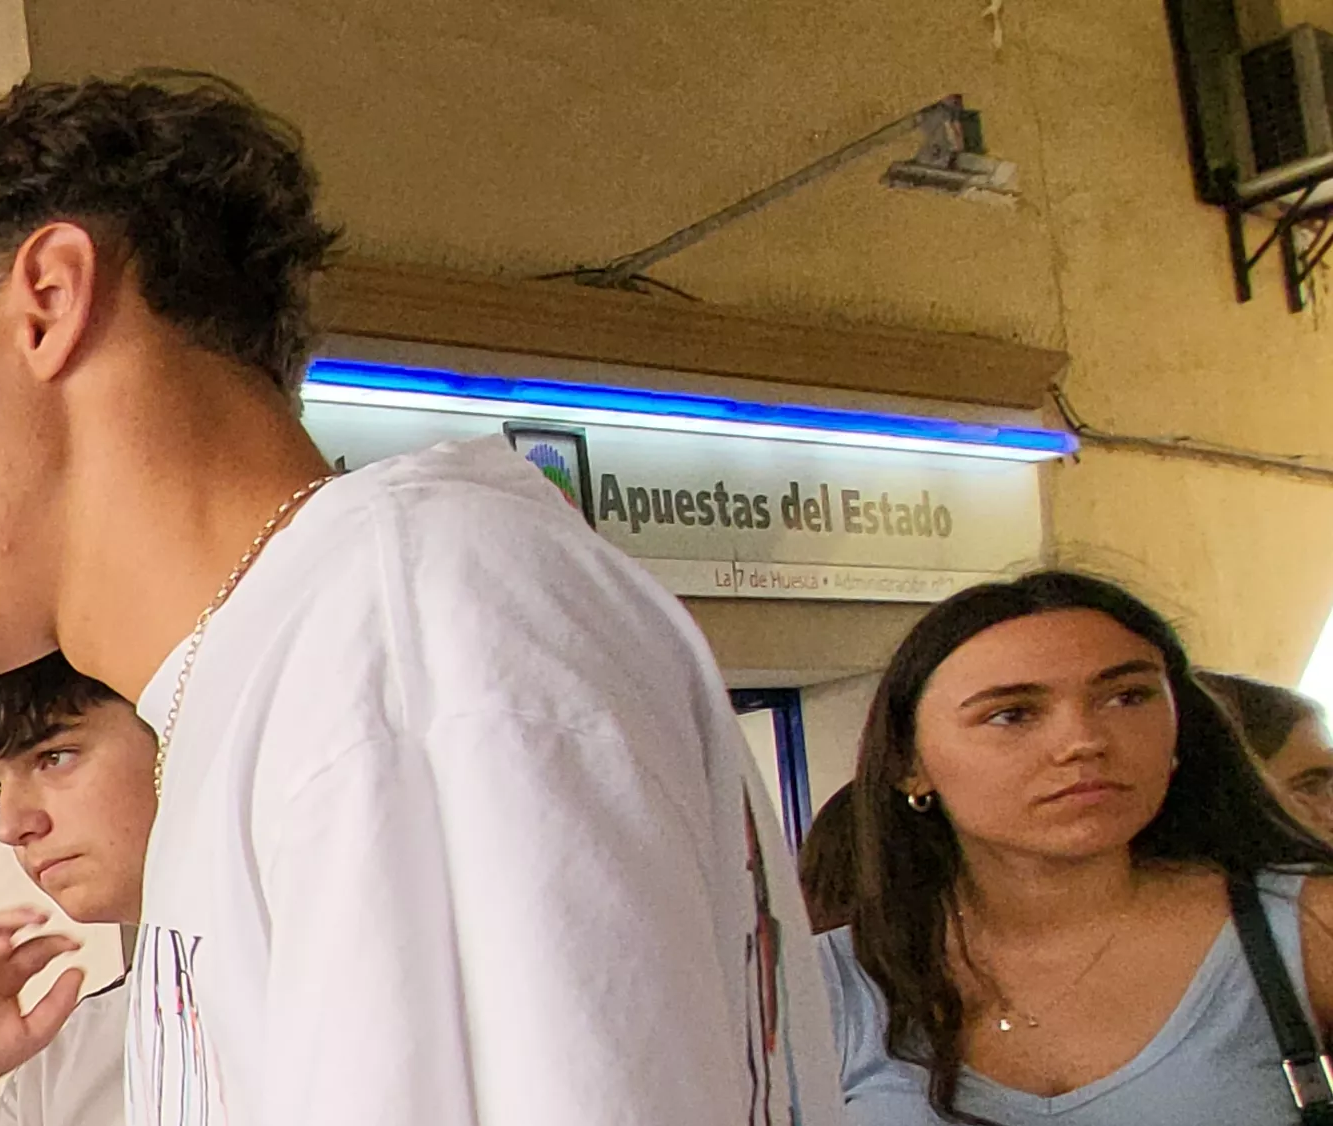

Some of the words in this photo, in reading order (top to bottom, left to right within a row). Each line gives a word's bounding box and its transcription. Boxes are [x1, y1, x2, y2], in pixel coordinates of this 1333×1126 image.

[599, 473, 772, 534] Apuestas
[781, 480, 833, 533] del
[841, 489, 953, 538] Estado
[715, 568, 731, 588] La
[737, 570, 744, 588] 7
[749, 570, 767, 588] de
[771, 571, 819, 590] Huesca
